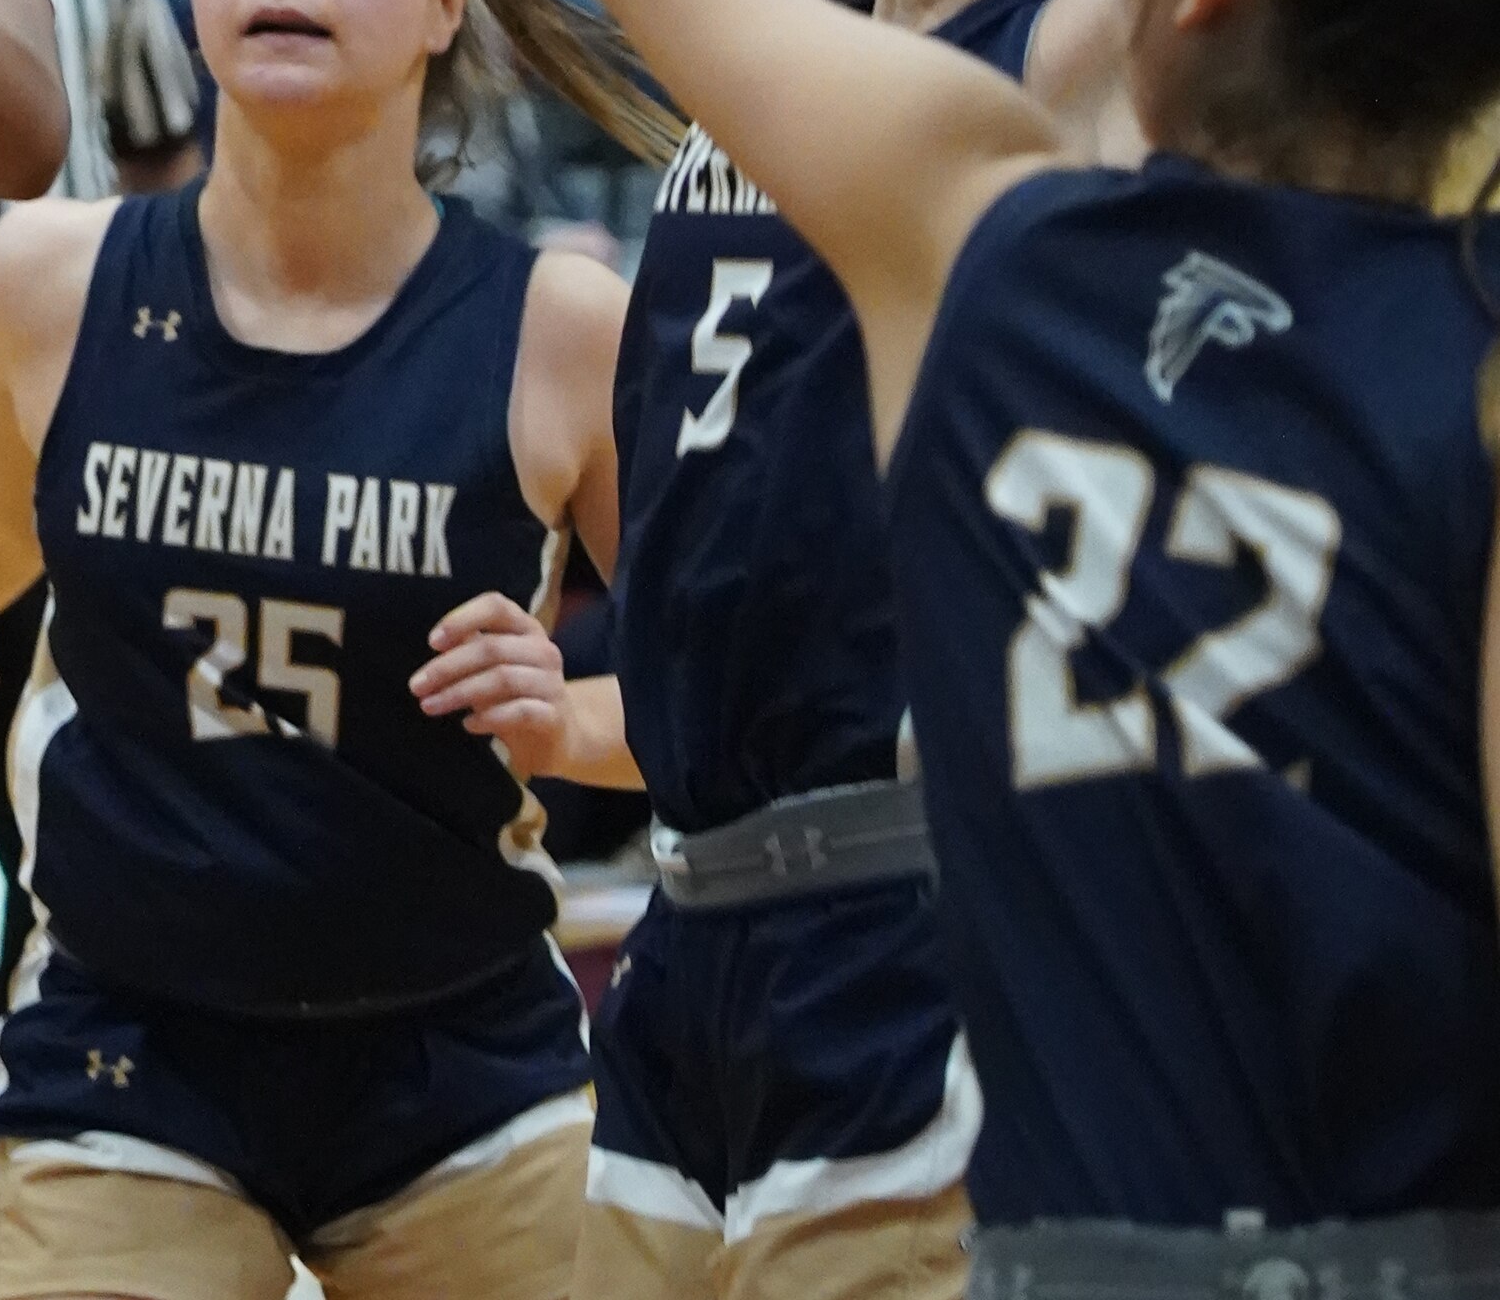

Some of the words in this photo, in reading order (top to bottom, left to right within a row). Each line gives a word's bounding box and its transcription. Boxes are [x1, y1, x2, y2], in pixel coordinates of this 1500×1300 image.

[675, 257, 774, 460] 5
[76, 441, 296, 561] SEVERNA
[320, 472, 457, 578] PARK
[161, 586, 346, 750] 25
[984, 427, 1343, 793] 22
